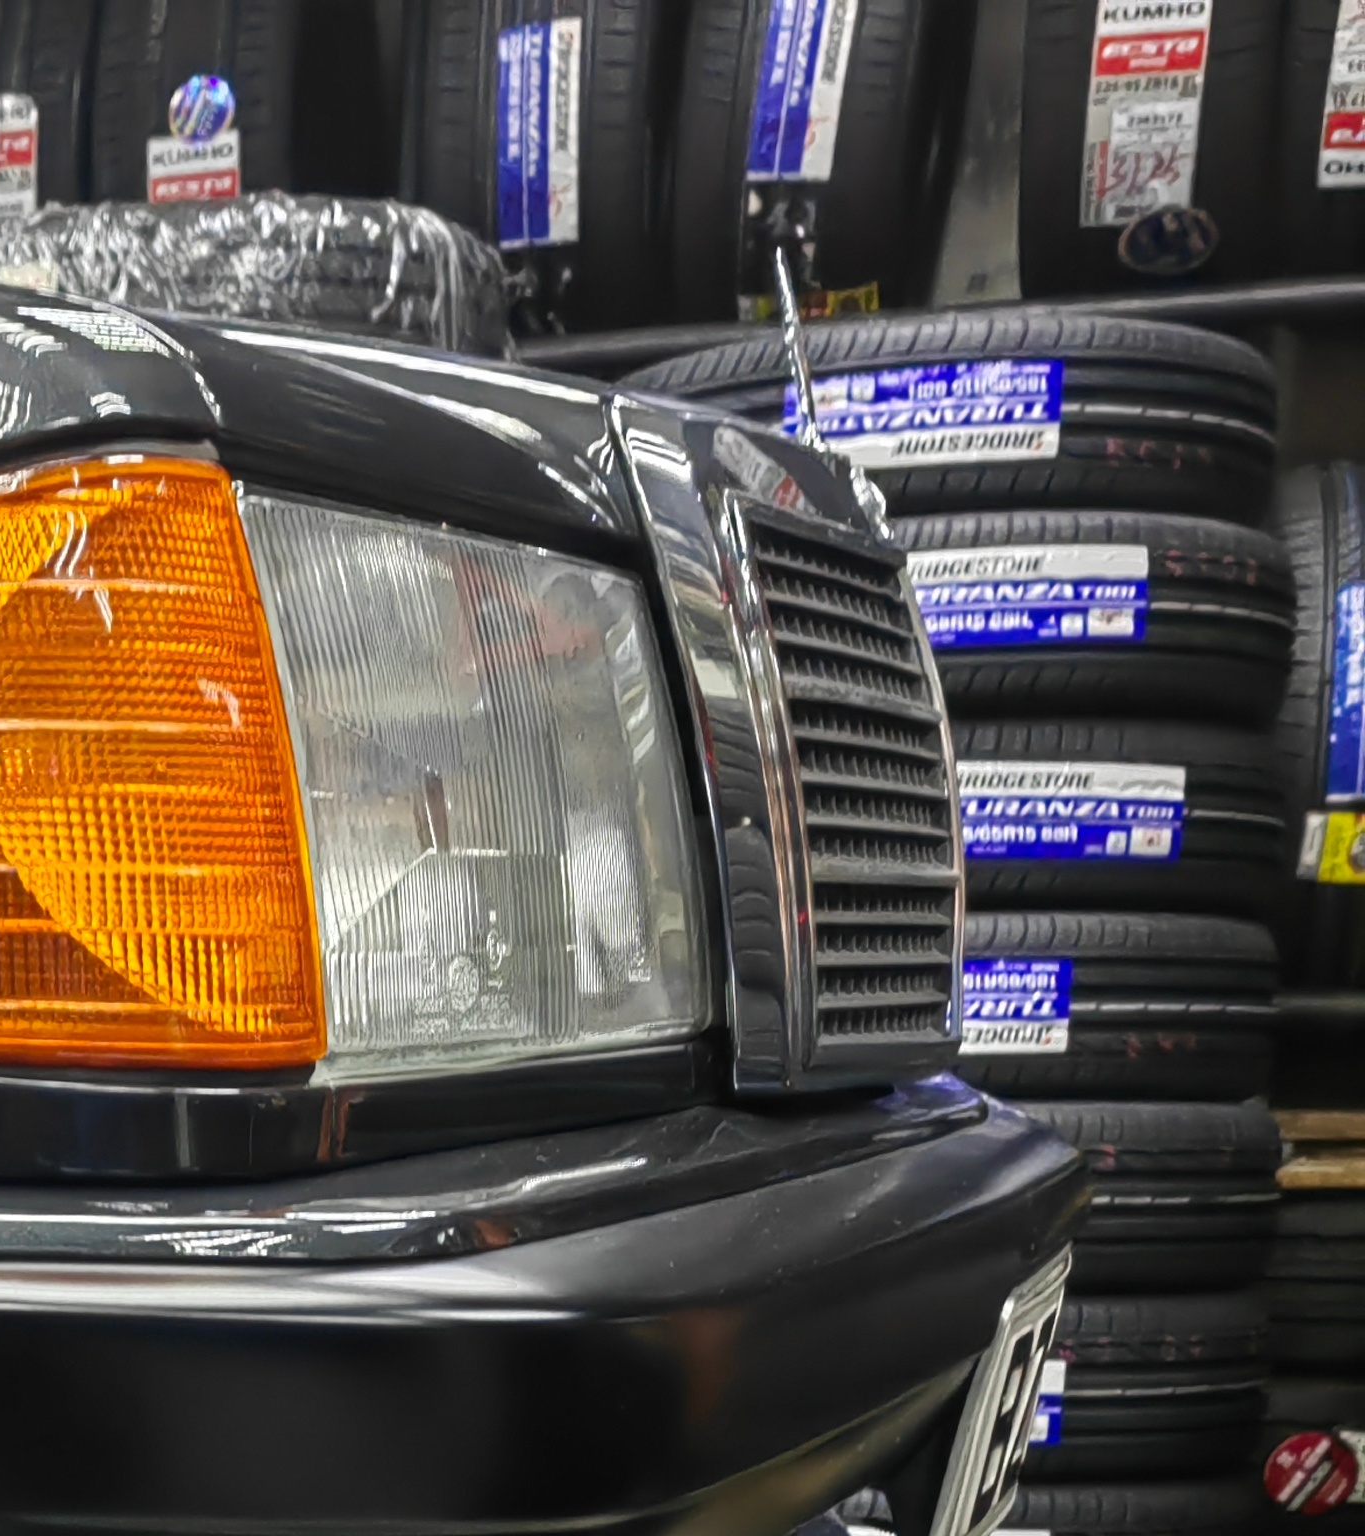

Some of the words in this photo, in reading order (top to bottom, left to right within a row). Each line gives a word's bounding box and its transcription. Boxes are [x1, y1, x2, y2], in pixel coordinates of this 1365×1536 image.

[1103, 3, 1206, 23] KUMHO
[862, 402, 1050, 432] TURANZA
[891, 429, 1044, 458] BRIDGESTONE
[964, 798, 1120, 818] URANZA
